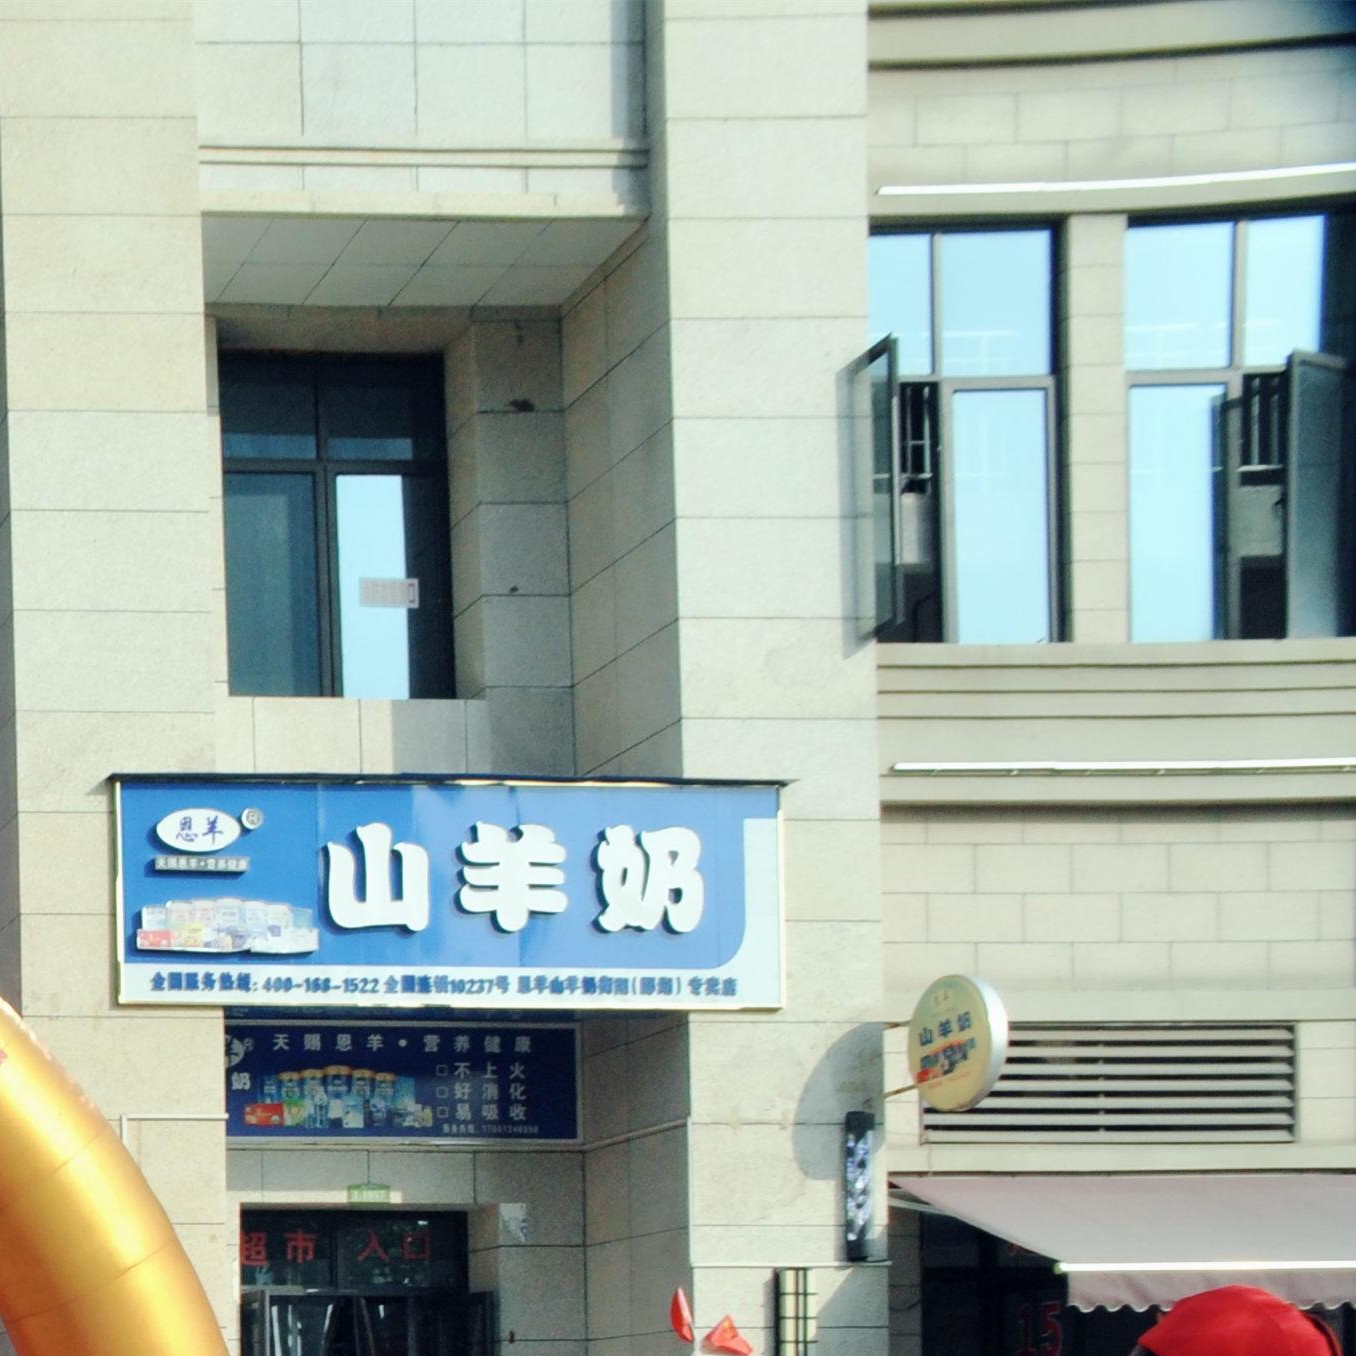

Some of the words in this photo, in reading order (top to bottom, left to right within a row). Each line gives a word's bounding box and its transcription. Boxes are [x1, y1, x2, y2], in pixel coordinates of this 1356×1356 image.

[176, 815, 224, 845] 恩羊
[328, 822, 704, 933] 山羊奶
[454, 1062, 526, 1080] 不上火
[454, 1082, 527, 1100] 好消化
[454, 1103, 527, 1121] 易吸收
